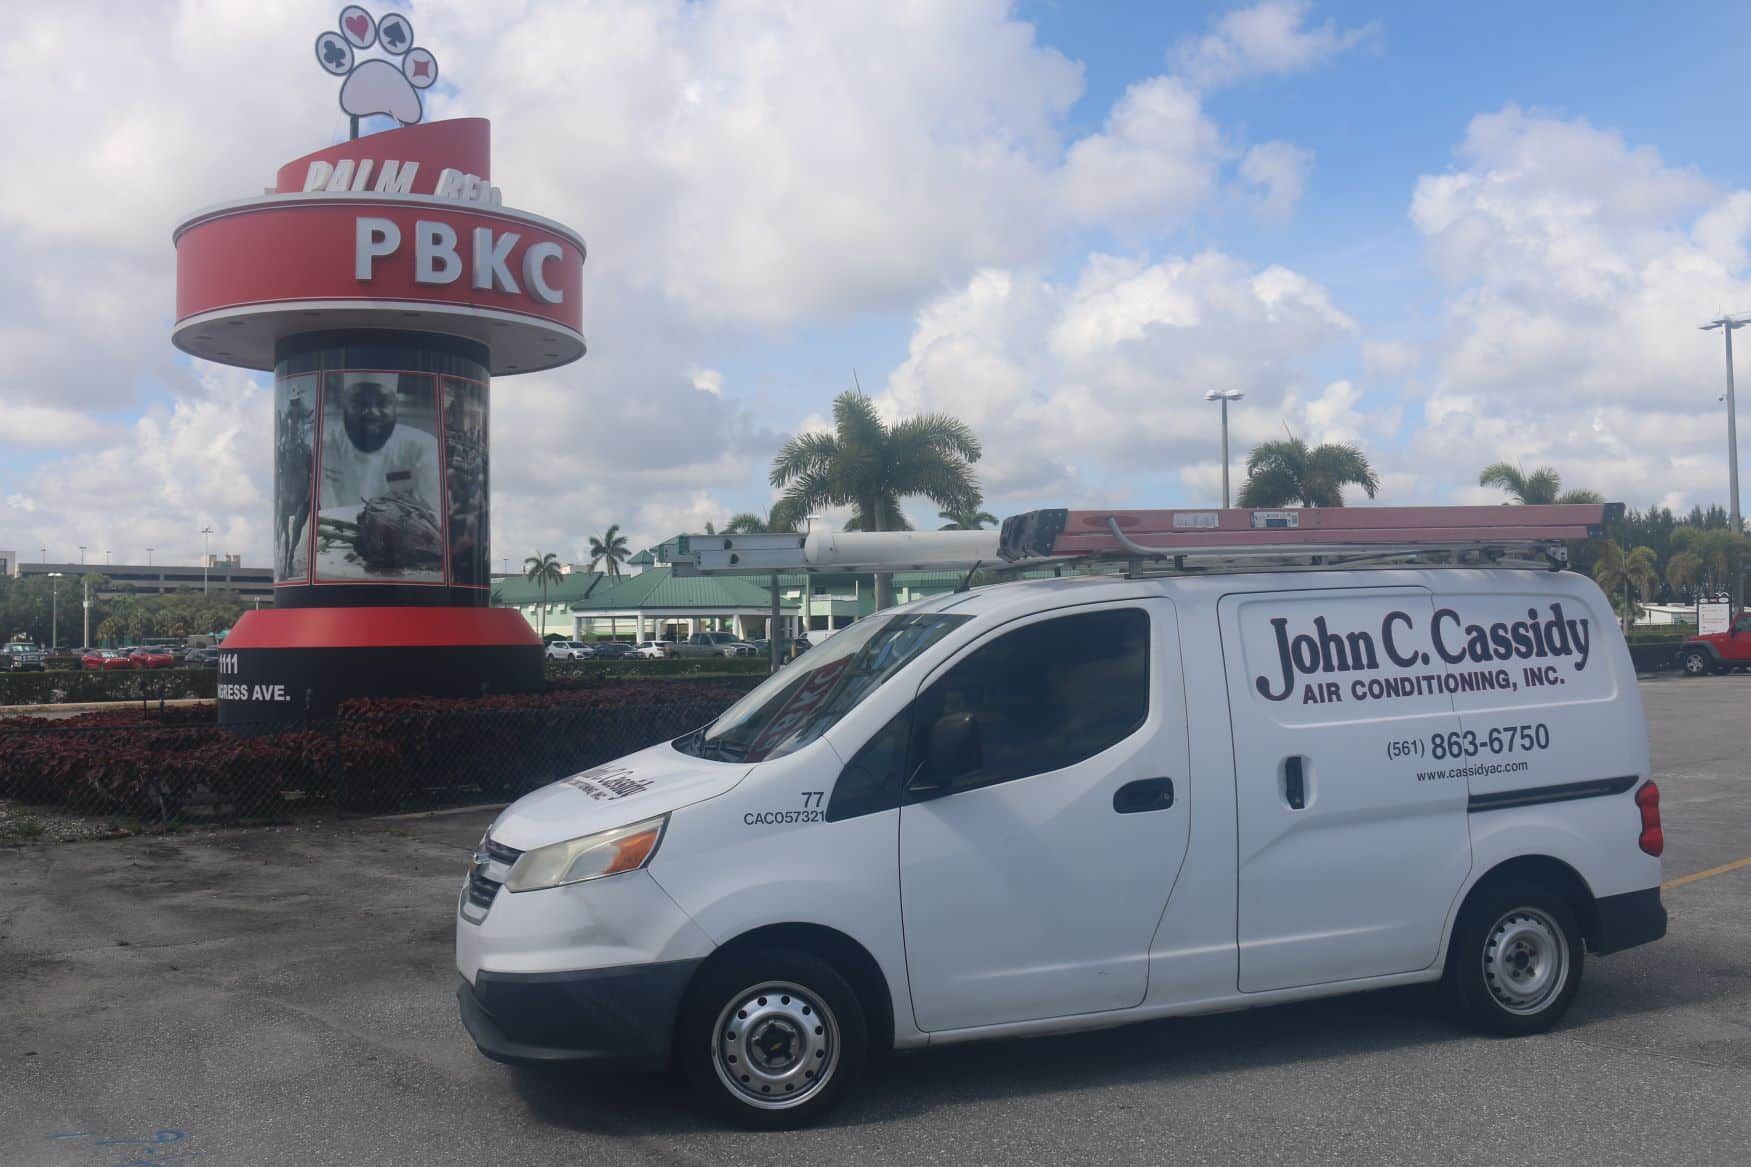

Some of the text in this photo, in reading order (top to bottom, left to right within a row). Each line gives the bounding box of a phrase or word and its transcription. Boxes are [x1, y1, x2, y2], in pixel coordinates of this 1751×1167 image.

[303, 159, 420, 193] PALM
[355, 217, 564, 304] PBKC
[219, 653, 238, 674] 1111
[1256, 602, 1590, 701] John C. Cassidy
[252, 684, 291, 701] AVE.
[1302, 666, 1566, 705] AIR CONDITIONING, INC.
[1387, 723, 1550, 760] (561) 863-6750
[1416, 761, 1528, 782] www.cassidyac.com
[801, 791, 824, 808] 77
